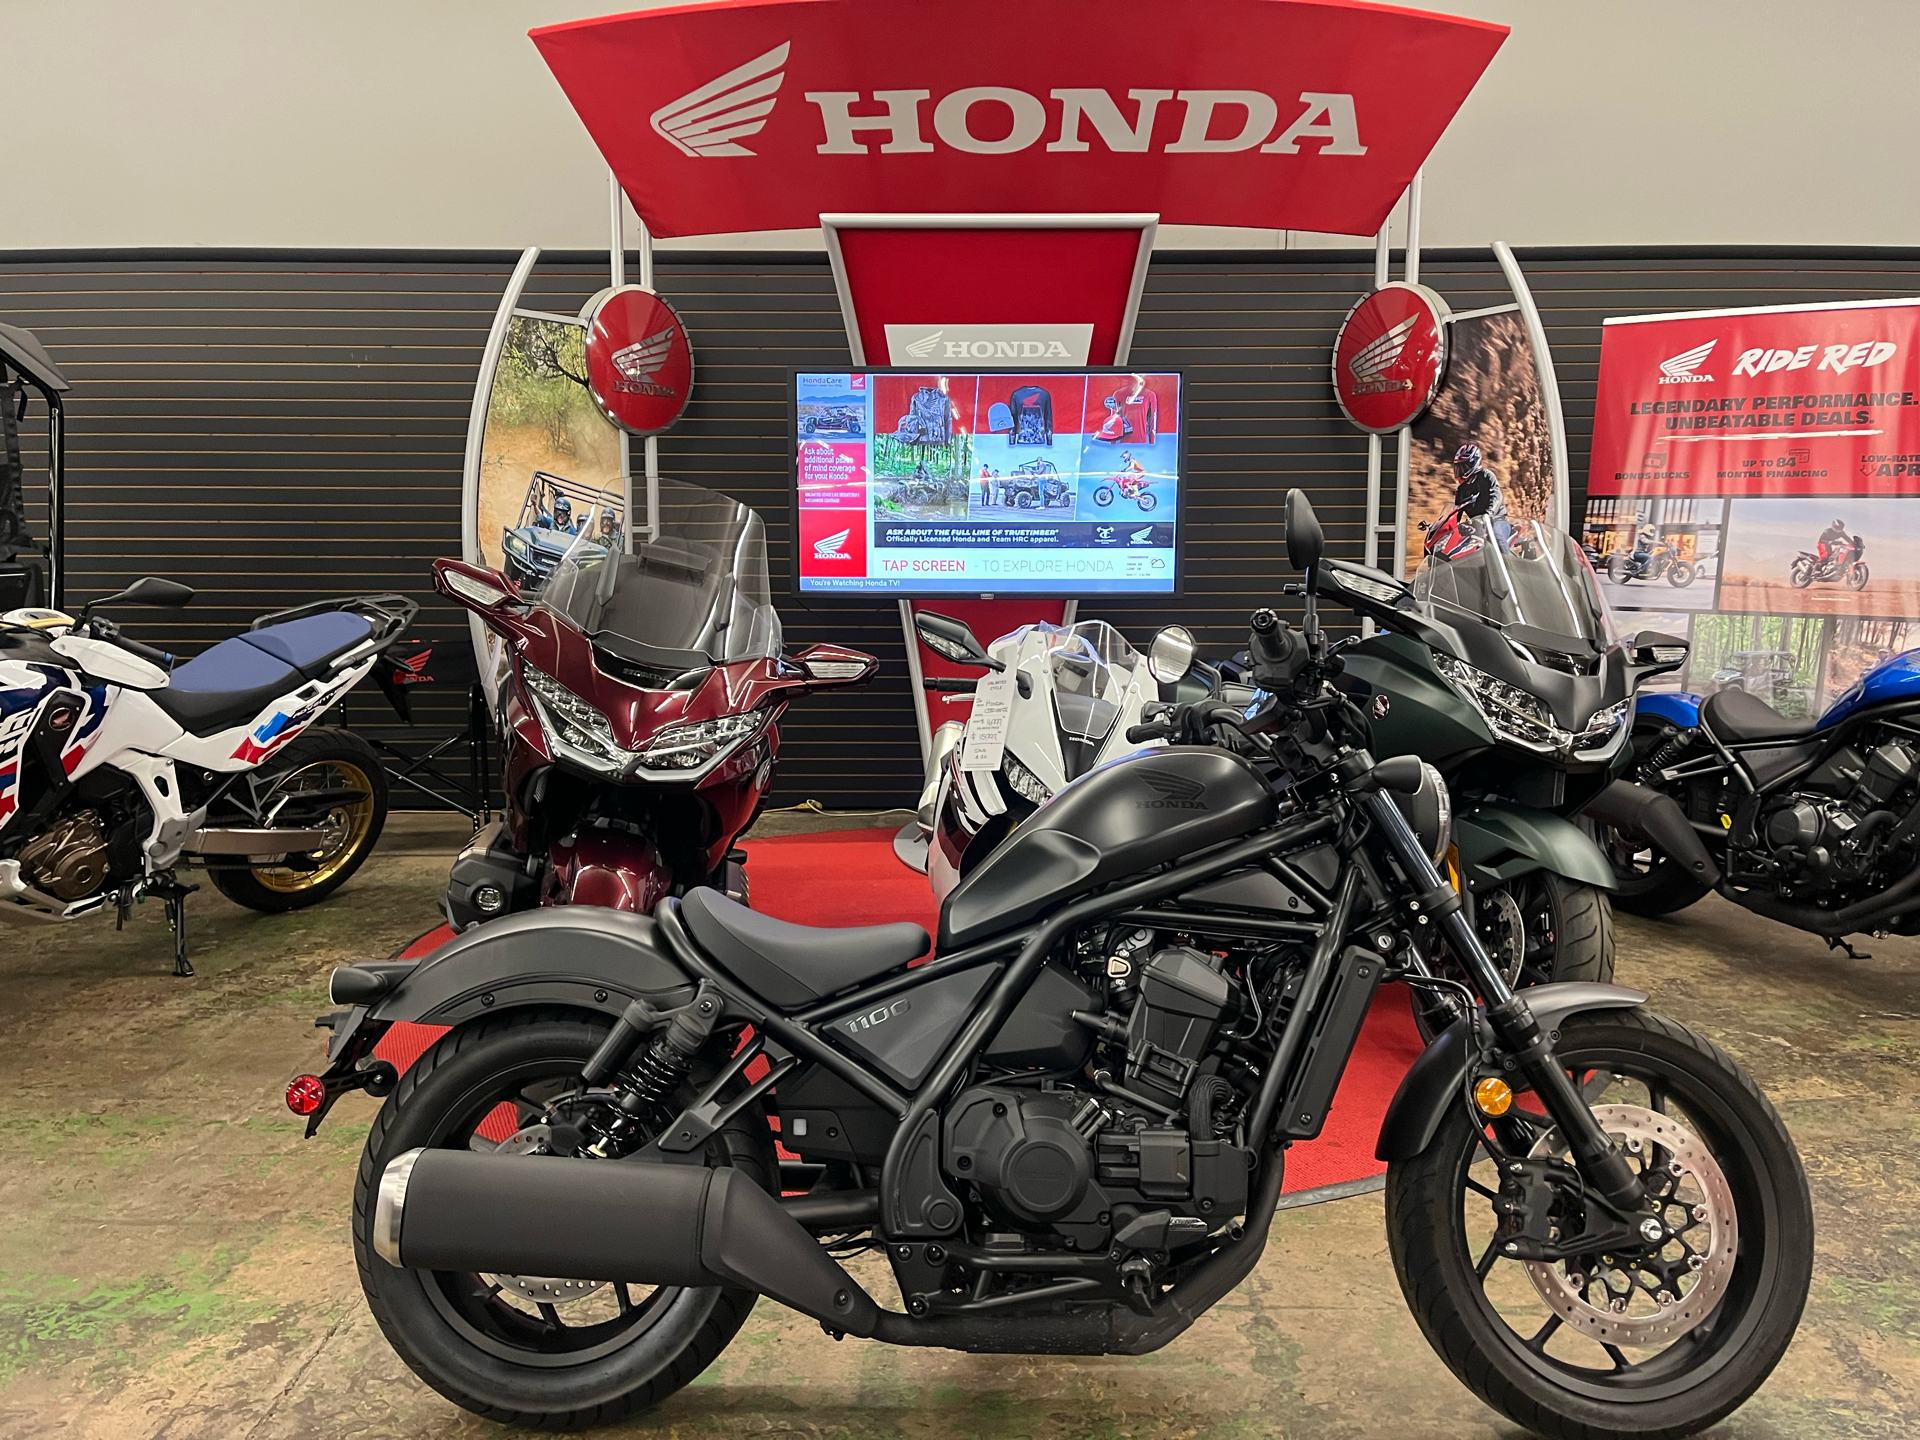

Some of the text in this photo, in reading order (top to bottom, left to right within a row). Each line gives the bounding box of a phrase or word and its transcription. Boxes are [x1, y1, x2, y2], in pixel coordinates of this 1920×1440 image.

[804, 86, 1369, 156] HONDA
[943, 341, 1072, 358] HONDA
[1731, 340, 1897, 378] RIDE RED
[1658, 374, 1715, 385] HONDA
[613, 380, 676, 398] HONDA
[1351, 378, 1416, 396] HONDA
[1630, 392, 1919, 415] LEGENDARY PERFORMANCE.
[1665, 410, 1875, 430] UNBEATABLE DEALS.
[804, 447, 834, 455] Ask about
[804, 456, 853, 465] additional peae
[1776, 457, 1797, 467] 84
[828, 465, 856, 474] coverage
[1766, 470, 1828, 478] FINANCING
[1876, 463, 1920, 476] APR
[804, 472, 848, 481] for your Honda
[1615, 471, 1690, 480] BONUS BUCKS
[886, 528, 904, 536] ASK
[904, 528, 933, 536] ABOUT
[934, 528, 950, 536] THE
[951, 528, 971, 536] FULL
[886, 535, 918, 543] Officially
[1029, 536, 1059, 544] apparel.
[882, 559, 908, 572] TAP
[912, 559, 965, 572] SCREEN
[982, 559, 1000, 572] TO
[1004, 559, 1062, 572] EXPLORE
[1066, 559, 1114, 572] HONDA
[810, 579, 900, 588] You're Watching Honda TV!
[1069, 736, 1095, 747] HONDA
[1135, 800, 1210, 811] HONDA
[845, 999, 911, 1033] 1100
